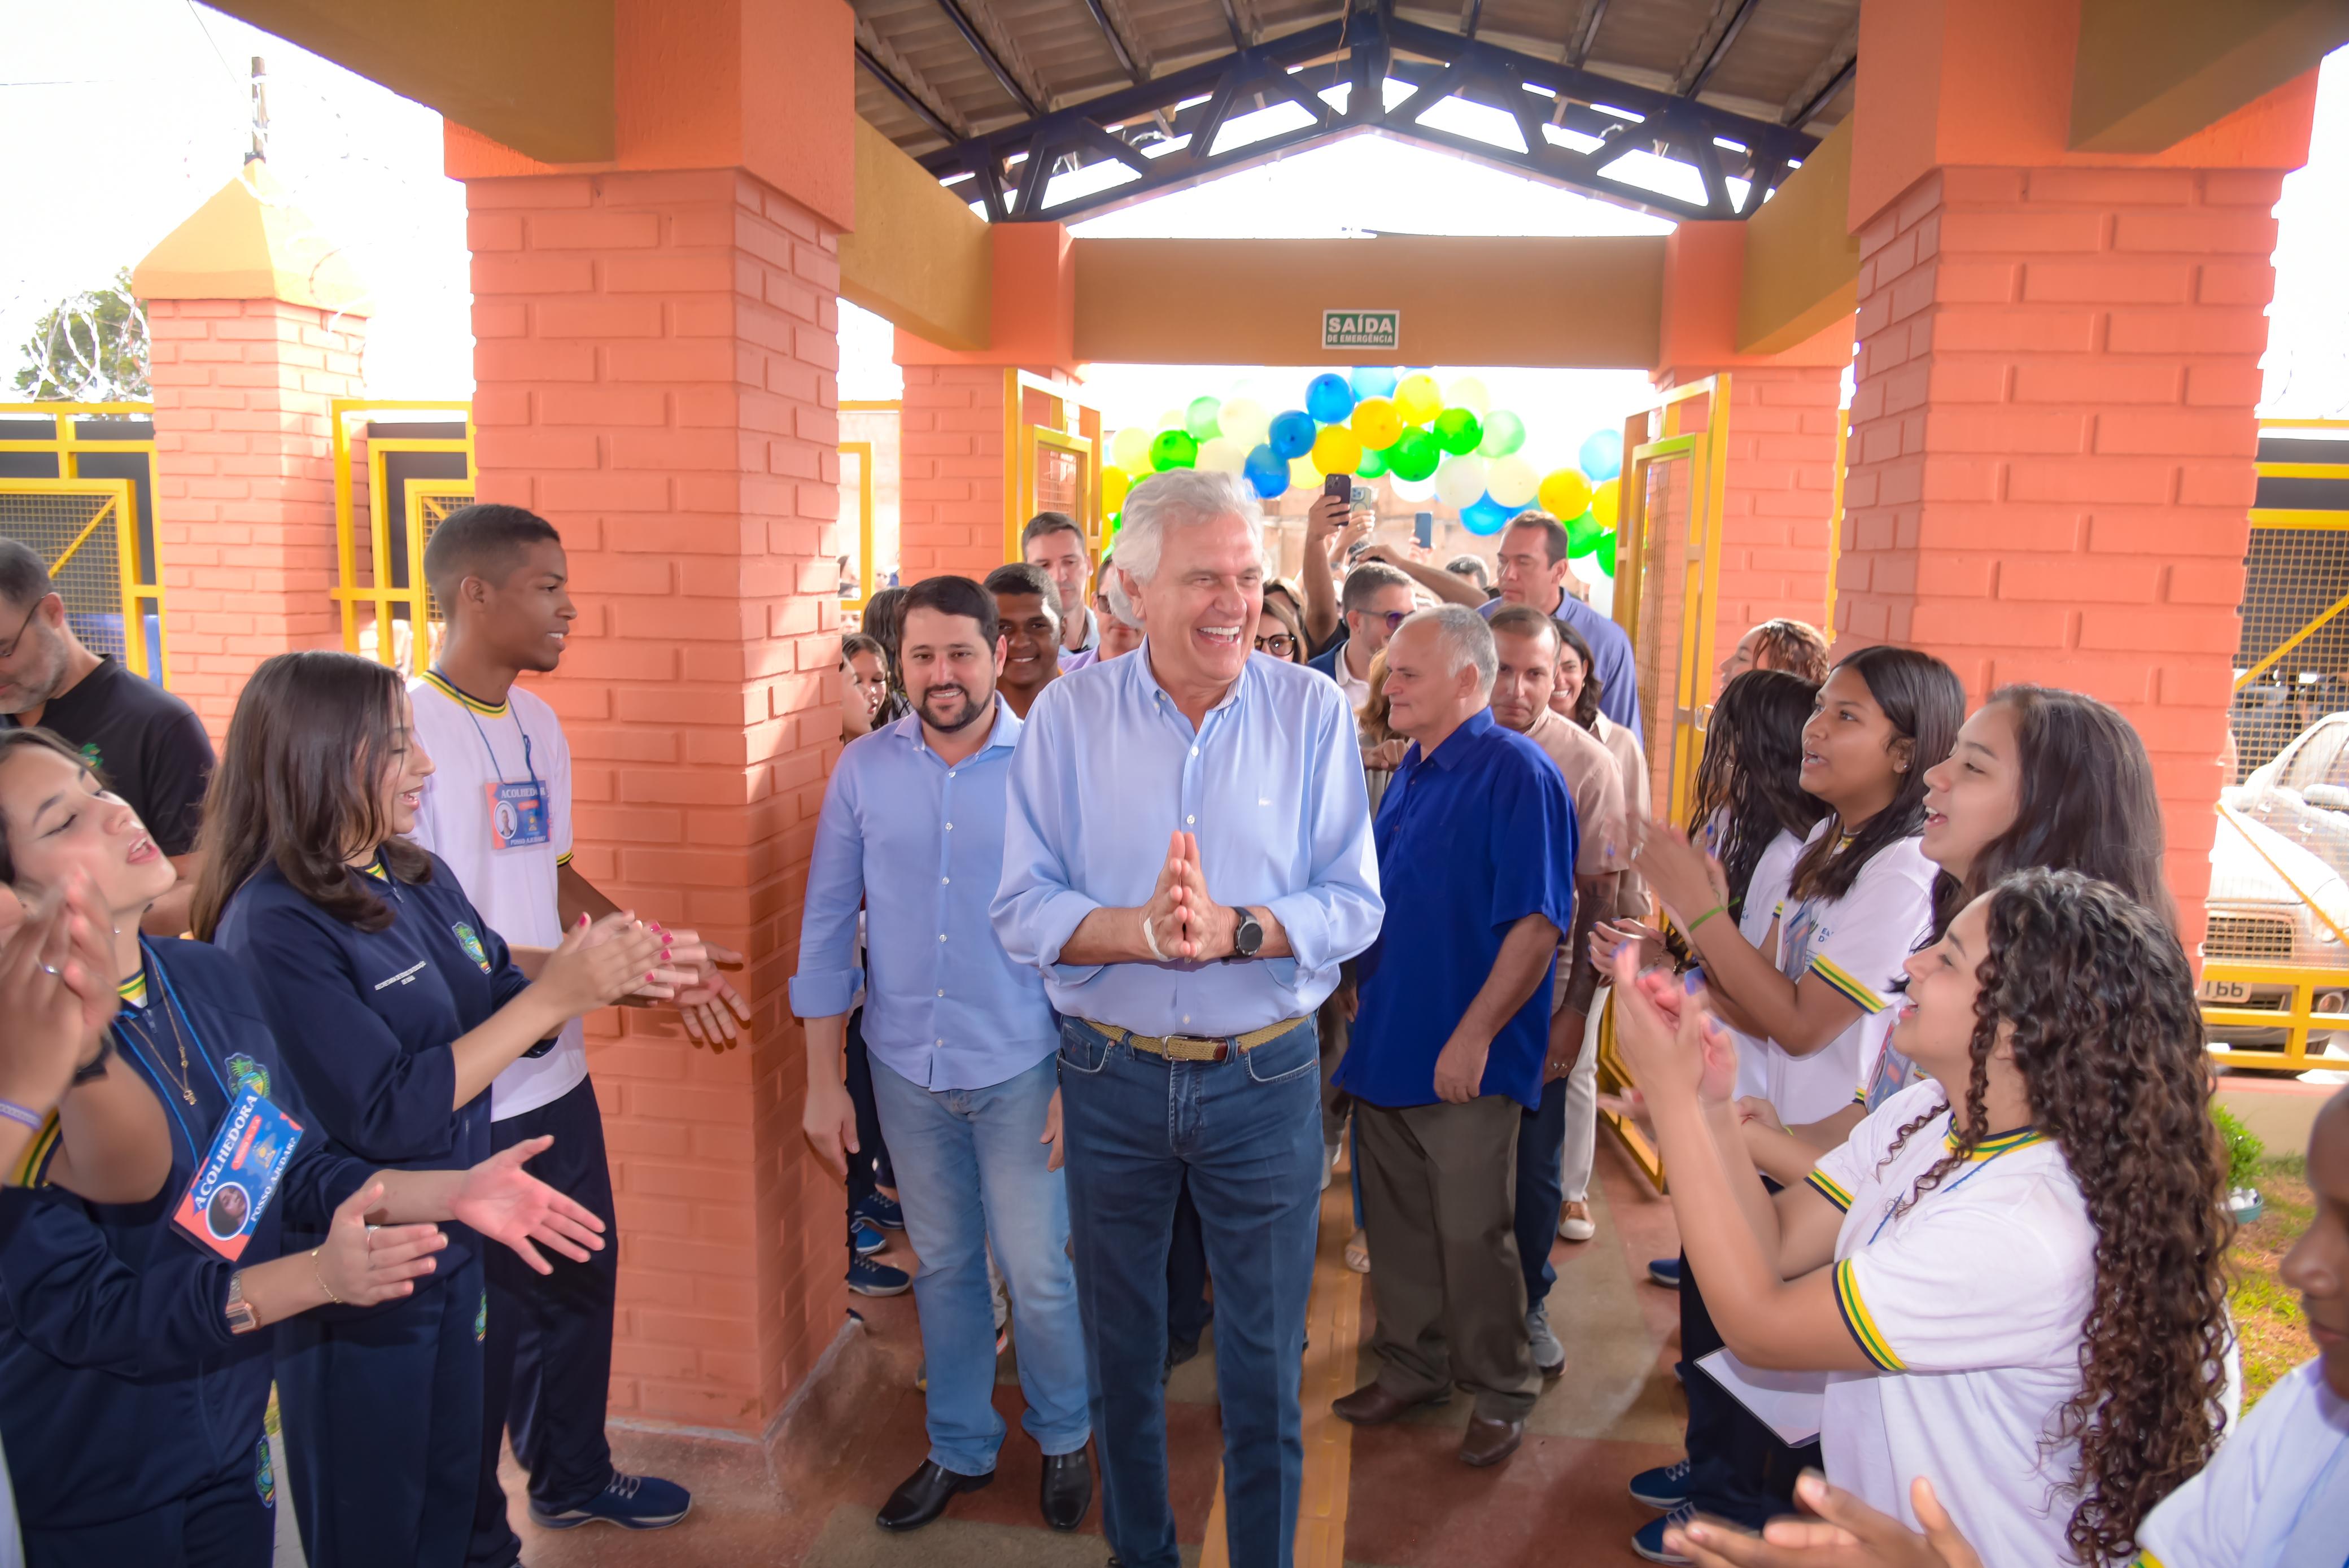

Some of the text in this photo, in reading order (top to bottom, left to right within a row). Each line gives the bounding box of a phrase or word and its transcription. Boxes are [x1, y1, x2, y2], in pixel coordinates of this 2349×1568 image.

[1327, 333, 1393, 343] DE EMERGÊNCIA
[1328, 314, 1393, 333] SAÍDA
[194, 1094, 259, 1209] ACOLHEDORA
[250, 1136, 296, 1222] POSSO AJUDAR?
